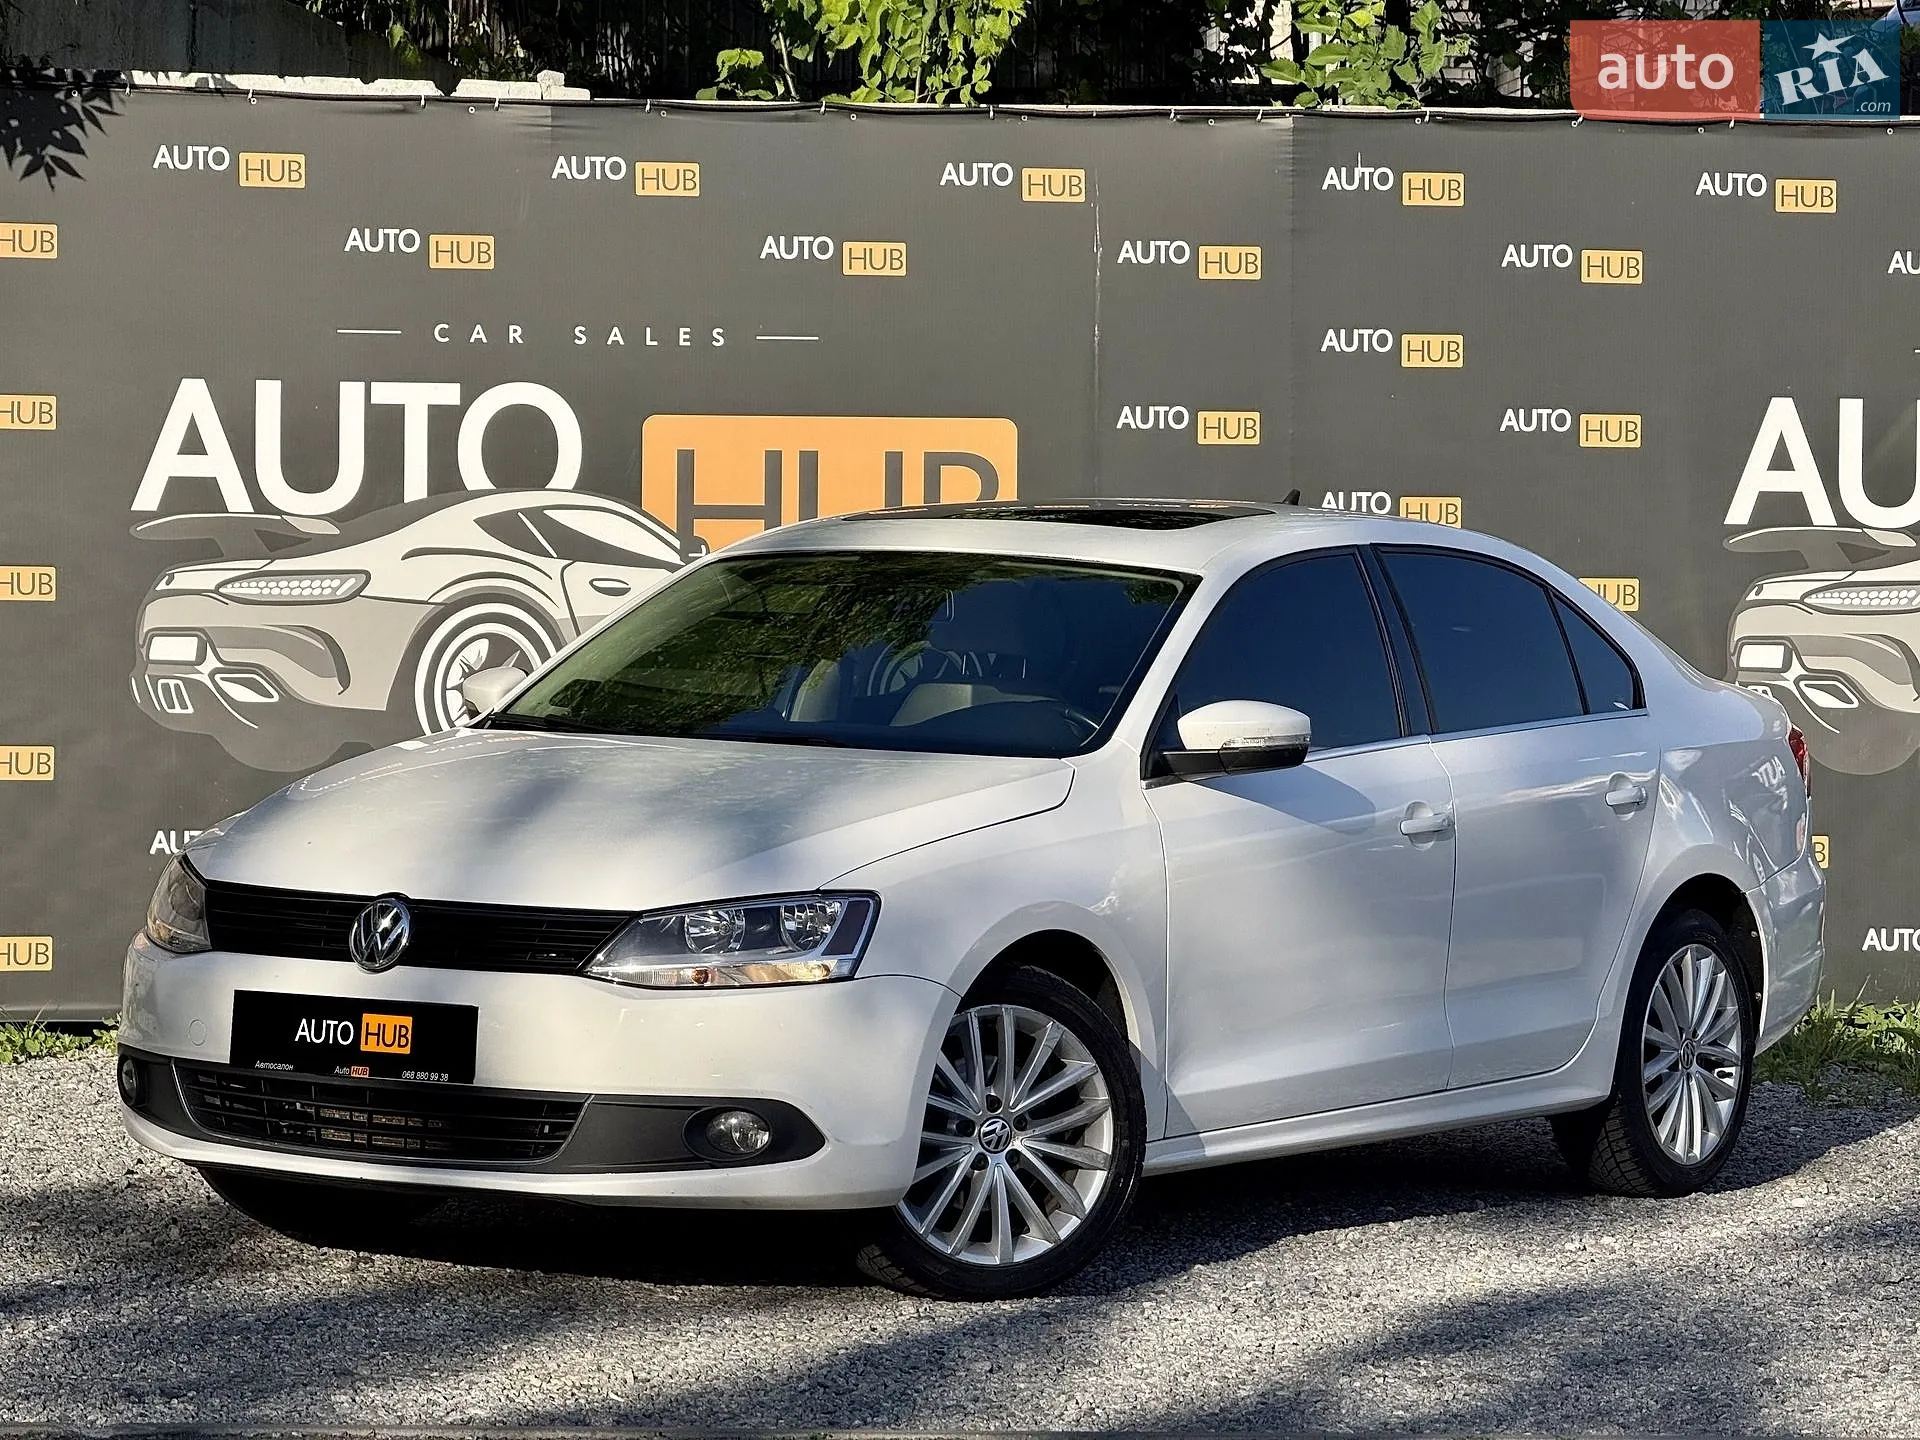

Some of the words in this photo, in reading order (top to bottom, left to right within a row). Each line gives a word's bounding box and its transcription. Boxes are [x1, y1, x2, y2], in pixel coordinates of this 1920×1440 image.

[153, 145, 229, 170] AUTO
[246, 159, 302, 183] HUB
[552, 156, 626, 180] AUTO
[642, 168, 699, 190] HUB
[940, 163, 1013, 186] AUTO
[1028, 175, 1082, 197] HUB
[1322, 167, 1393, 191] AUTO
[1409, 179, 1461, 201] HUB
[1696, 173, 1767, 197] AUTO
[1781, 185, 1833, 207] HUB
[344, 228, 420, 253] AUTO
[436, 241, 491, 264] HUB
[760, 236, 834, 260] AUTO
[849, 248, 904, 271] HUB
[1117, 241, 1190, 265] AUTO
[1205, 252, 1258, 274] HUB
[1502, 244, 1572, 268] AUTO
[1587, 256, 1639, 279] HUB
[434, 324, 523, 344] CAR
[574, 325, 725, 347] SALES
[1321, 329, 1393, 353] AUTO
[1408, 340, 1460, 362] HUB
[1117, 406, 1190, 430] AUTO
[1204, 417, 1257, 440] HUB
[1500, 409, 1571, 433] AUTO
[1586, 420, 1638, 442] HUB
[131, 378, 582, 515] AUTO
[1321, 492, 1392, 517] AUTO
[1408, 503, 1459, 525] HUB
[294, 1018, 354, 1046] AUTO
[364, 1022, 410, 1049] HUB
[254, 1060, 294, 1071] Автосалон
[334, 1065, 350, 1075] Auto
[351, 1067, 369, 1076] HUB
[401, 1070, 415, 1079] 068
[416, 1071, 428, 1081] 880
[430, 1072, 439, 1081] 99
[440, 1073, 449, 1082] 38
